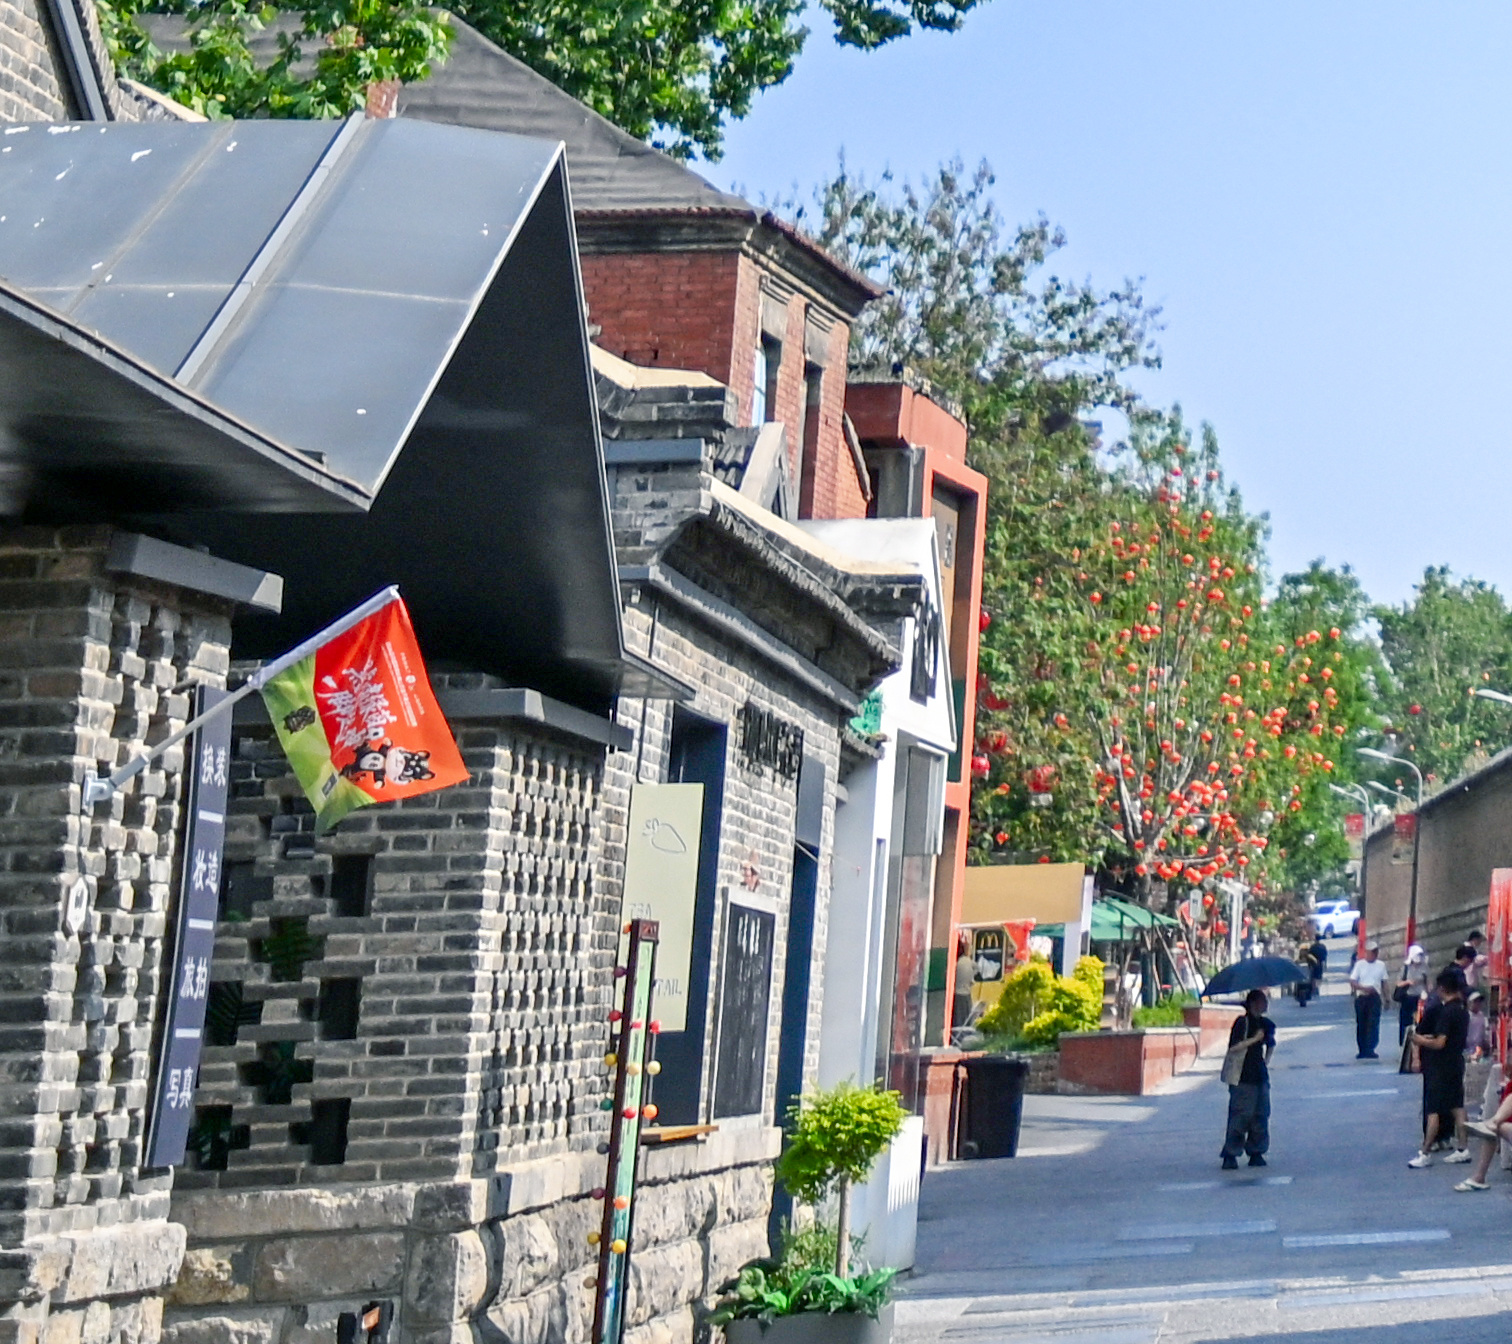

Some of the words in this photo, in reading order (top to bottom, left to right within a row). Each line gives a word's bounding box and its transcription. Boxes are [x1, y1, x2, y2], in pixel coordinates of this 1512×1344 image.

[201, 742, 227, 787] 换装
[193, 848, 219, 895] 妆造
[180, 956, 208, 1000] 旅拍
[166, 1066, 193, 1110] 写真
